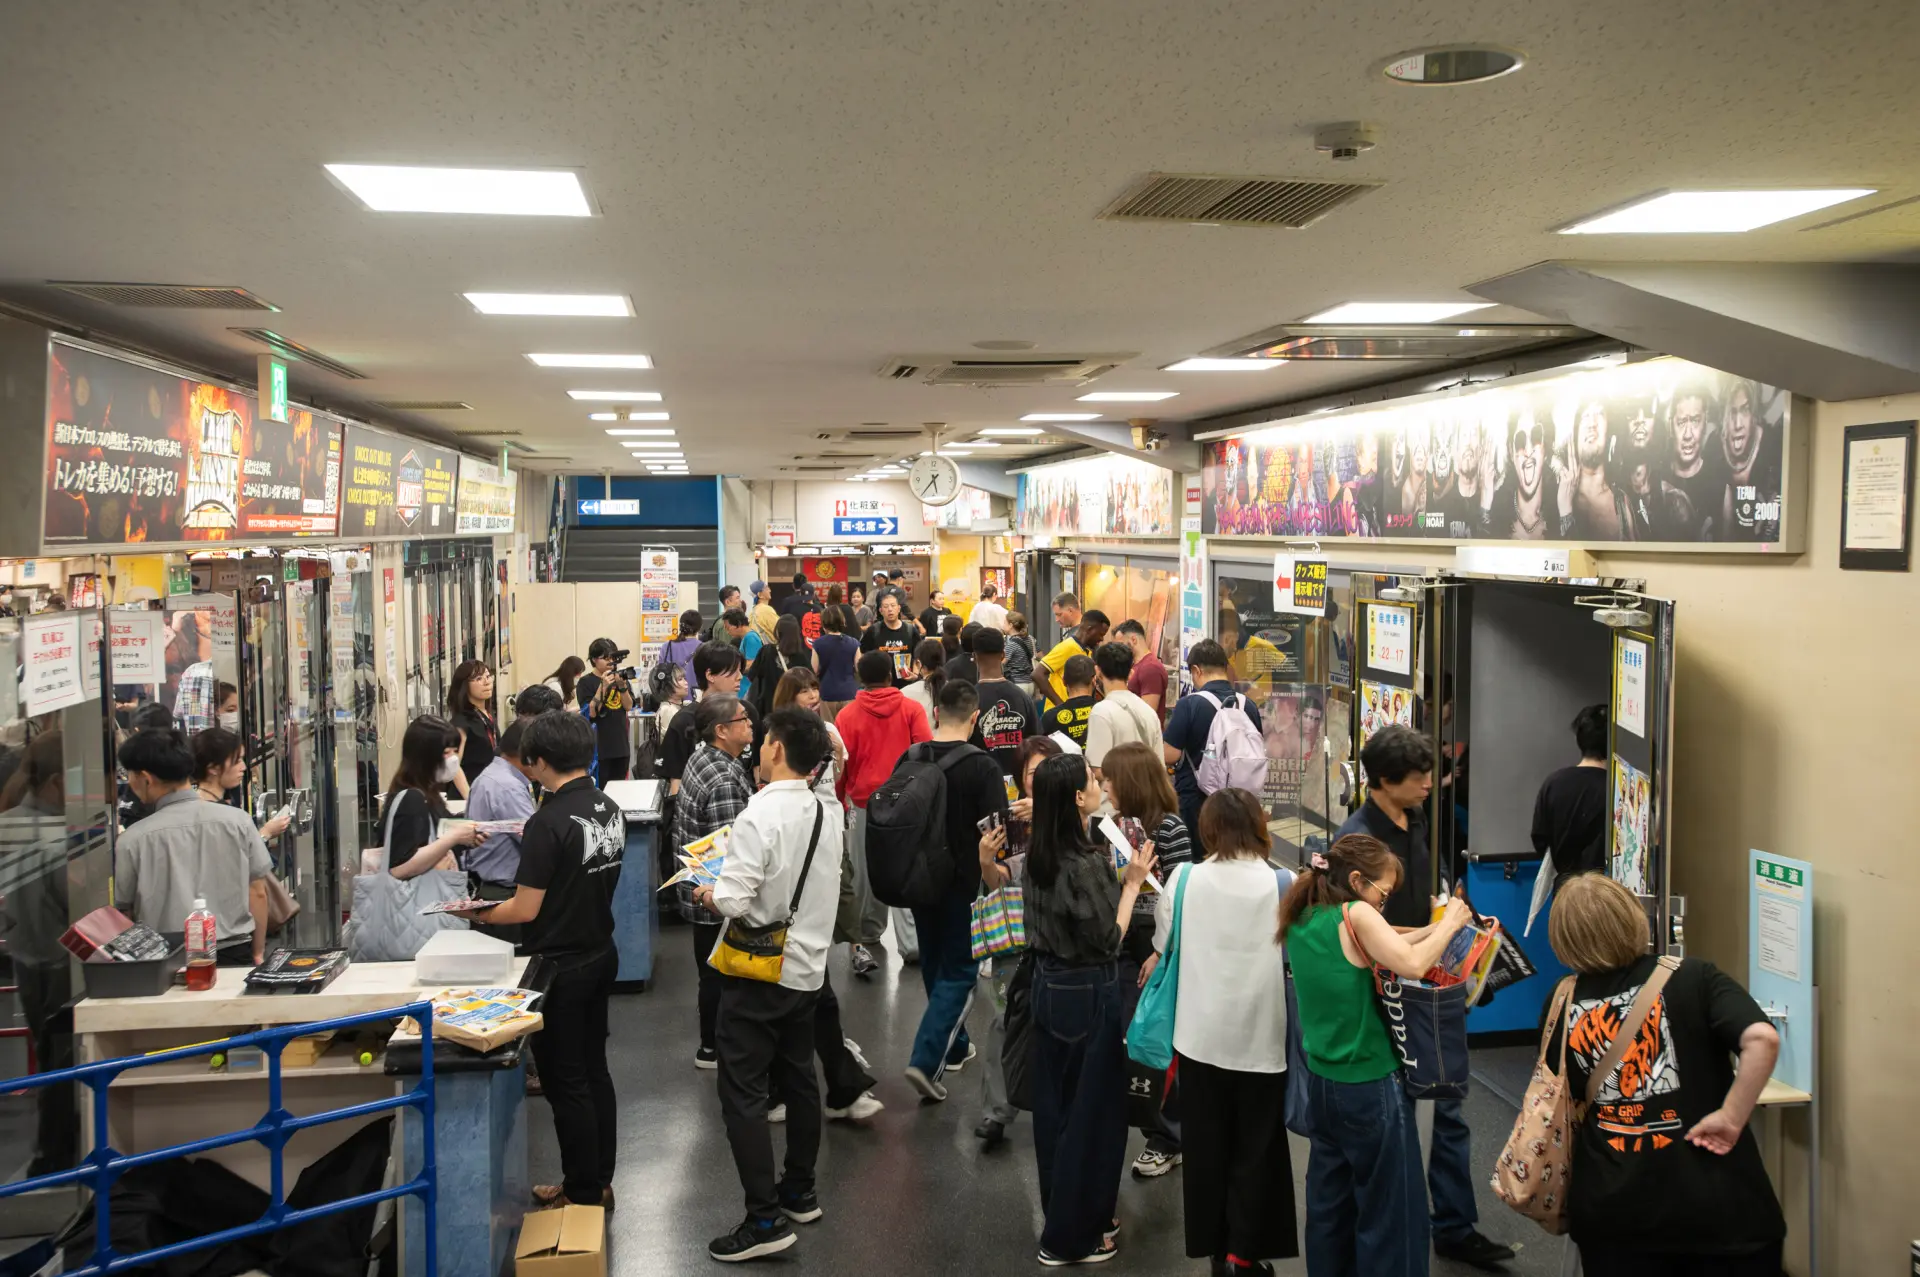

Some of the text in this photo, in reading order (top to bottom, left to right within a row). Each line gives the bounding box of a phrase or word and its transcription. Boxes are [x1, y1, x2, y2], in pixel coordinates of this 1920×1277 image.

[1736, 485, 1756, 500] TEAM
[850, 500, 879, 510] 化粧室
[841, 520, 876, 532] 西・北席
[1426, 517, 1445, 527] NOAH
[1544, 560, 1549, 570] 2
[1381, 646, 1404, 662] 22 17
[1760, 862, 1799, 883] 消毒液
[1618, 1103, 1644, 1117] GRIP
